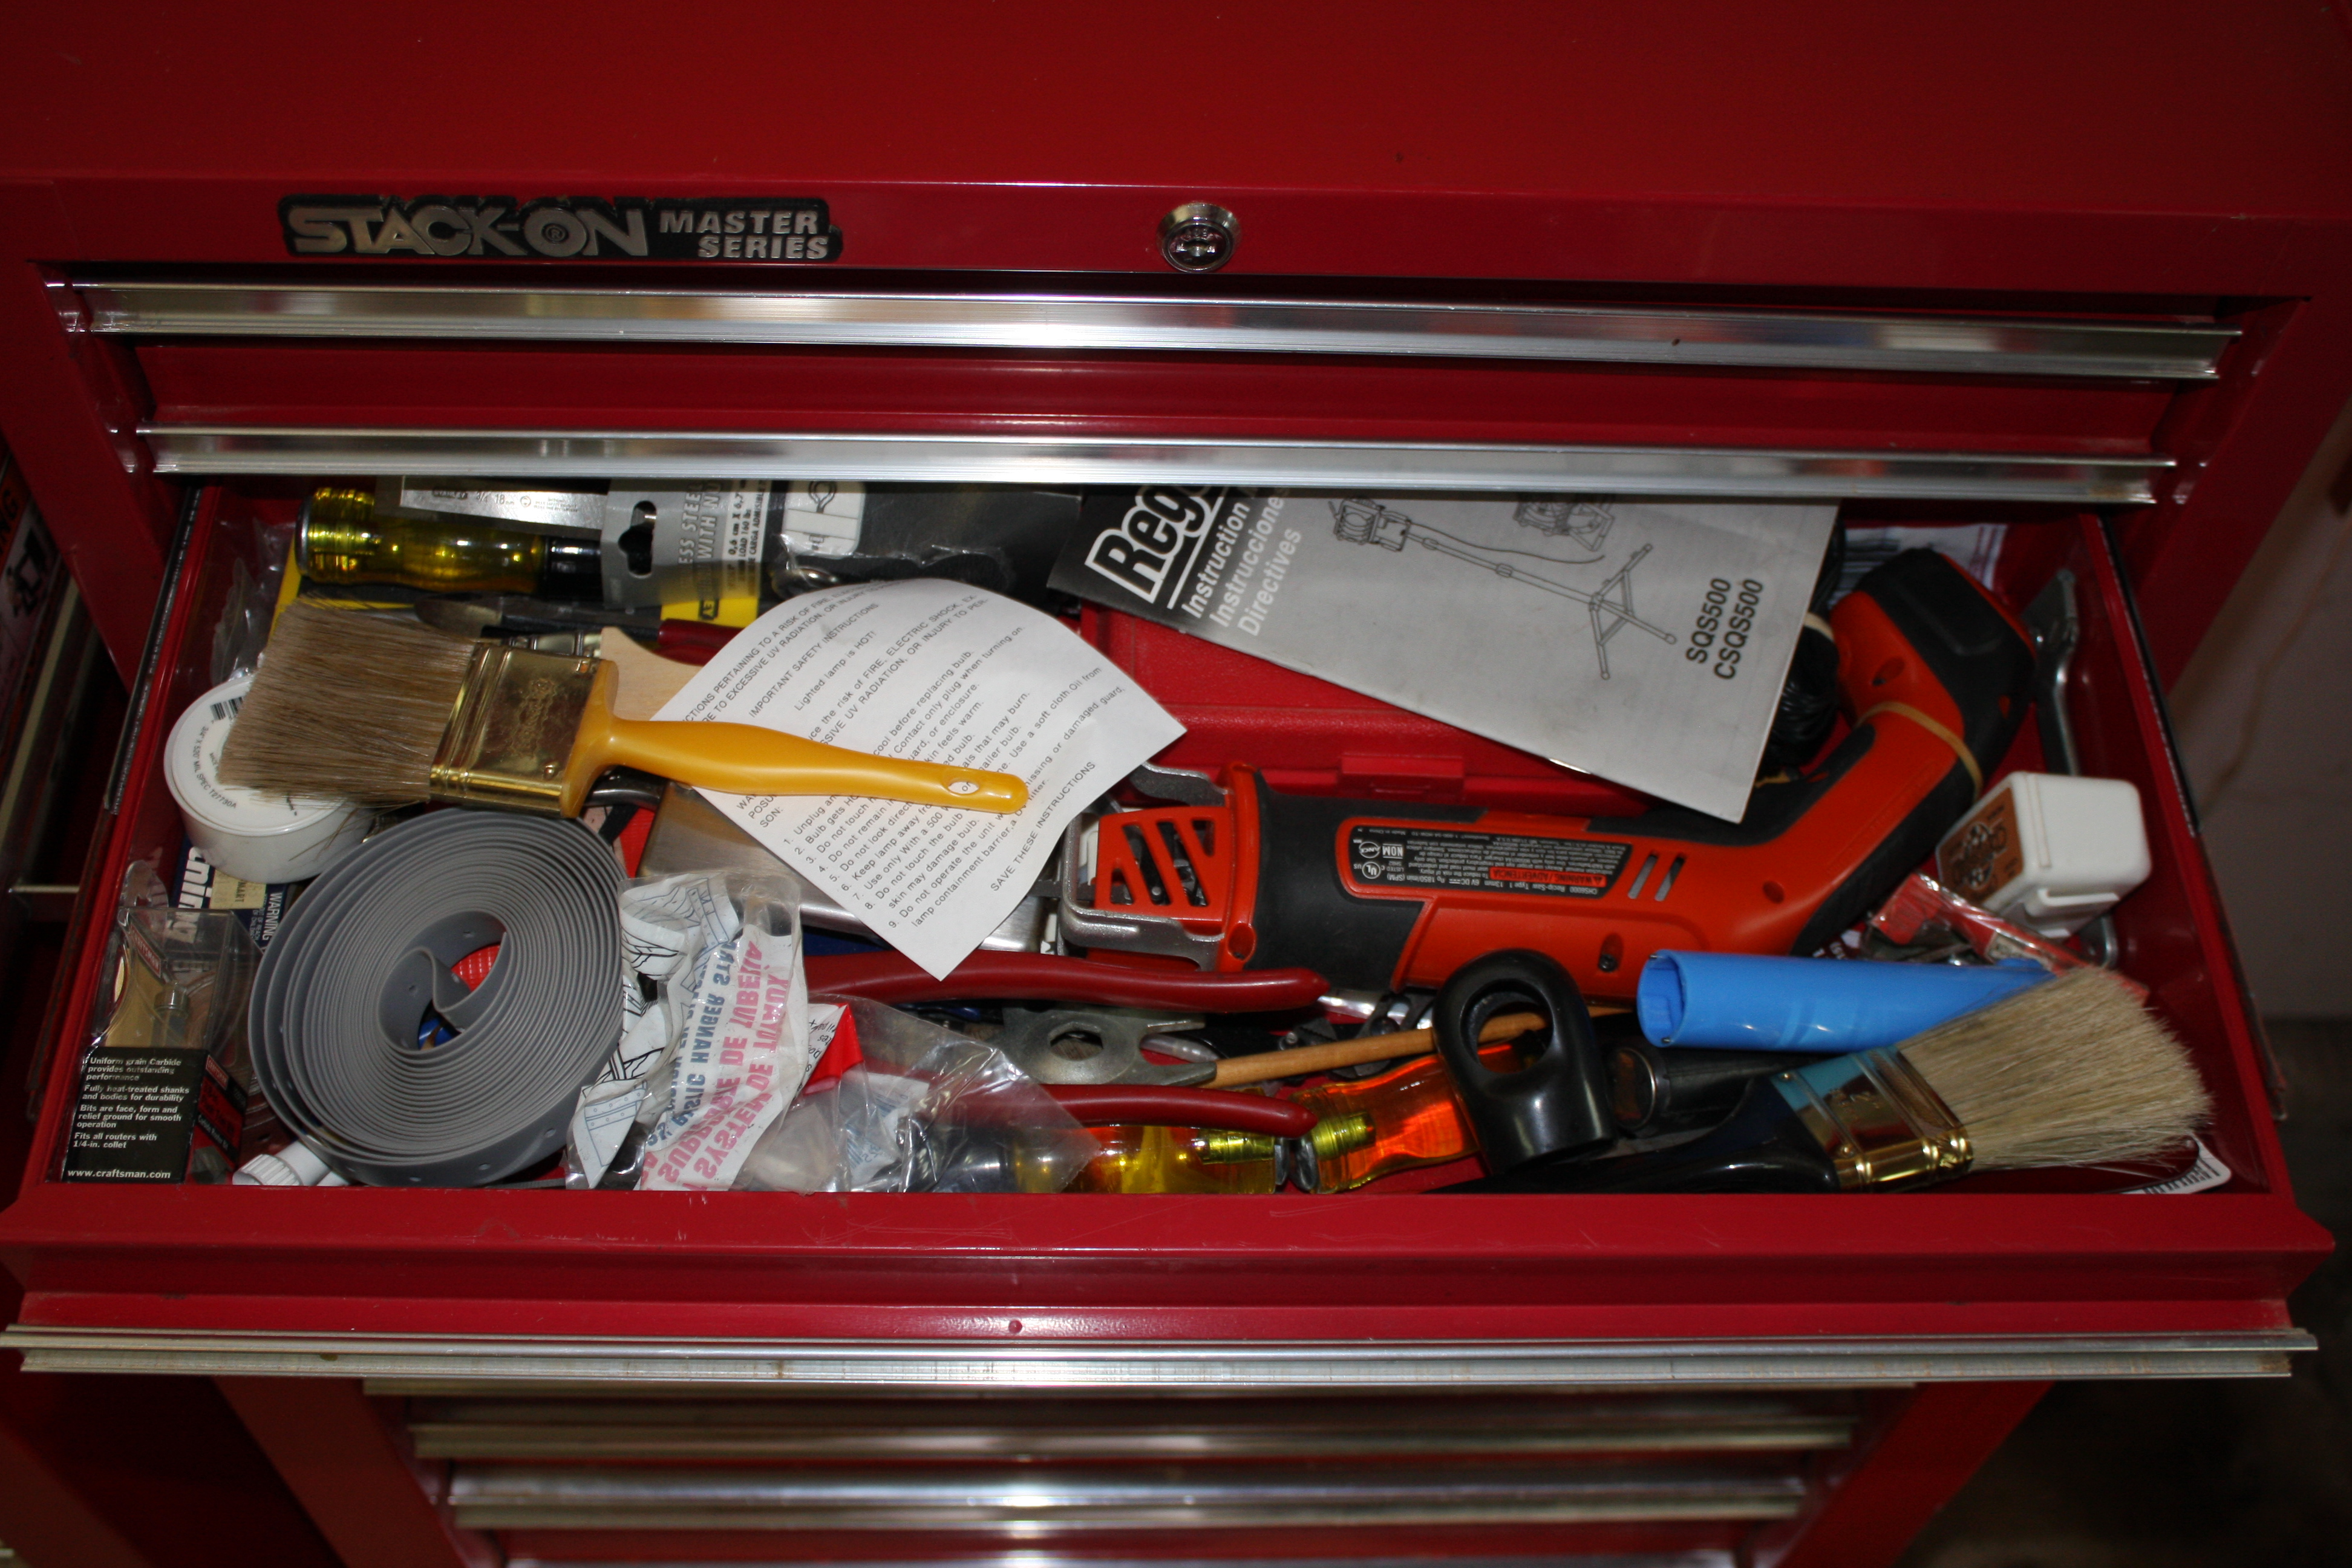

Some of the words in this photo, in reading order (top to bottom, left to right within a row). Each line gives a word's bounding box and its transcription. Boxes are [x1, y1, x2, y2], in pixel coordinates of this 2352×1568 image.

[289, 204, 648, 257] STACK-ON
[660, 210, 818, 235] MASTER
[698, 235, 829, 259] SERIES
[697, 515, 717, 559] WITH
[740, 521, 750, 535] 160
[749, 530, 759, 555] CARGA
[738, 538, 748, 557] LOAD
[1181, 501, 1250, 619] Instruction
[1237, 528, 1301, 636] Directives
[1685, 578, 1731, 664] SQS500
[1713, 578, 1763, 680] CSQS500
[685, 693, 715, 720] CTIONS
[713, 648, 760, 693] PERTAINING
[757, 636, 771, 647] TO
[778, 615, 799, 631] RISK
[798, 607, 809, 615] OF
[713, 700, 727, 712] TO
[725, 657, 768, 701] EXCESSIVE
[766, 646, 779, 658] UV
[748, 670, 792, 717] IMPORTANT
[792, 642, 822, 671] SAFETY
[822, 603, 878, 643] INSTRUCTIONS
[794, 679, 825, 711] Lighted
[824, 659, 846, 679] lamp
[854, 630, 874, 649] HOT!
[821, 710, 836, 724] the
[837, 691, 853, 708] risk
[854, 679, 863, 689] of
[862, 658, 887, 679] FIRE,
[886, 622, 928, 656] ELECTRIC
[844, 704, 858, 719] UV
[858, 658, 907, 704] RADIATION,
[907, 642, 922, 655] OR
[921, 618, 952, 641] INJURY
[873, 736, 890, 754] cool
[889, 708, 916, 736] before
[916, 668, 954, 707] replacing
[951, 652, 971, 668] bulb.
[893, 720, 925, 753] Contact
[924, 701, 942, 720] only
[941, 681, 961, 701] plug
[960, 659, 982, 679] when
[981, 635, 1012, 658] turning
[929, 726, 938, 737] or
[939, 684, 979, 725] enclosure.
[1008, 740, 1027, 757] Use
[1034, 710, 1050, 728] soft
[1081, 667, 1101, 681] from
[937, 727, 959, 749] feels
[958, 702, 984, 725] warm.
[974, 735, 992, 753] that
[991, 715, 1009, 735] may
[1007, 693, 1030, 714] burn.
[999, 727, 1021, 746] bulb.
[1053, 742, 1061, 753] or
[1063, 702, 1099, 740] damaged
[1099, 686, 1124, 705] guard,
[952, 734, 975, 754] bulb.
[197, 773, 211, 791] SPEC
[759, 807, 783, 828] SON:
[793, 806, 825, 834] Unplug
[805, 825, 826, 844] Bulb
[826, 806, 845, 825] gets
[844, 803, 869, 826] touch
[857, 806, 886, 835] remain
[990, 865, 1015, 891] SAVE
[1013, 830, 1037, 864] THESE
[1035, 761, 1095, 828] INSTRUCTIONS
[851, 859, 875, 881] Keep
[874, 838, 897, 858] lamp
[897, 815, 920, 837] away
[863, 874, 882, 889] Use
[883, 855, 901, 873] only
[899, 836, 920, 854] With
[926, 811, 942, 828] 500
[867, 826, 888, 844] look
[1382, 846, 1403, 857] NOM
[875, 886, 890, 899] Do
[890, 871, 906, 886] not
[904, 848, 929, 871] touch
[928, 833, 944, 846] the
[942, 812, 962, 832] bulb
[888, 891, 907, 909] skin
[906, 872, 926, 890] may
[926, 839, 958, 872] damage
[956, 820, 979, 838] bulb.
[898, 905, 913, 918] Do
[915, 889, 930, 904] not
[930, 857, 962, 888] operate
[961, 841, 977, 855] the
[978, 822, 995, 839] unit
[910, 906, 934, 927] lamp
[934, 856, 984, 906] containment
[1387, 873, 1405, 881] (SPM)
[1406, 875, 1436, 883] 1850/min
[1484, 880, 1504, 888] 13mm
[1494, 870, 1549, 881] ADVERTENCIA
[1514, 881, 1529, 890] Type
[1532, 883, 1566, 892] Recip-Saw
[1555, 874, 1593, 884] WARNING
[262, 892, 283, 941] WARNING
[90, 1057, 123, 1065] Uniform
[149, 1057, 181, 1066] Carbide
[83, 1083, 104, 1093] Fully
[160, 1085, 189, 1094] shanks
[144, 1094, 184, 1103] durability
[116, 1103, 136, 1113] face,
[139, 1104, 160, 1112] form
[139, 1132, 157, 1141] with
[67, 1168, 171, 1178] www.craftsman.com
